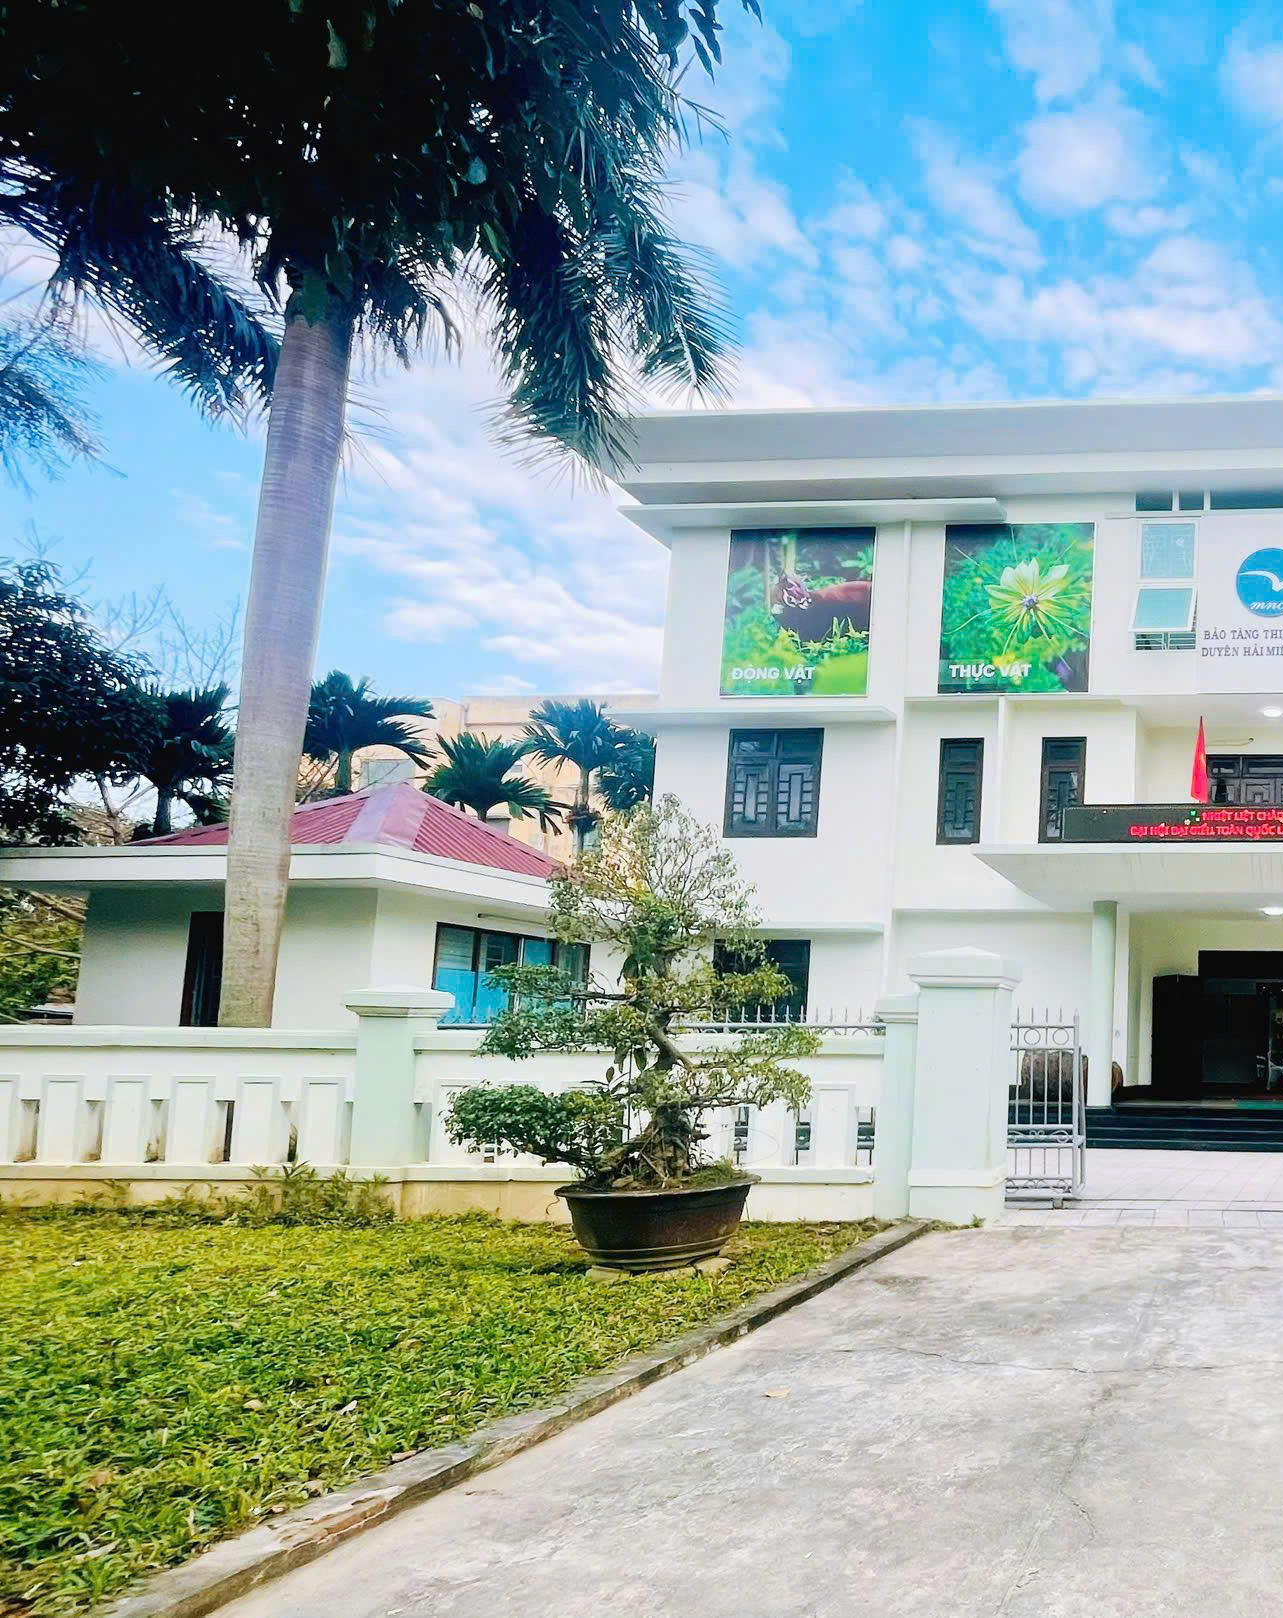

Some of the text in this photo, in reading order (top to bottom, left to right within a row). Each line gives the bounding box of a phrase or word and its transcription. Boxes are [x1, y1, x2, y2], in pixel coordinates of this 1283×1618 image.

[1203, 627, 1226, 640] BẢO
[1231, 627, 1259, 640] TÀNG
[1201, 645, 1239, 657] DUYÊN
[1243, 644, 1263, 657] HẢI
[732, 664, 816, 684] ĐỘNG VẬT
[949, 663, 995, 681] THỰC
